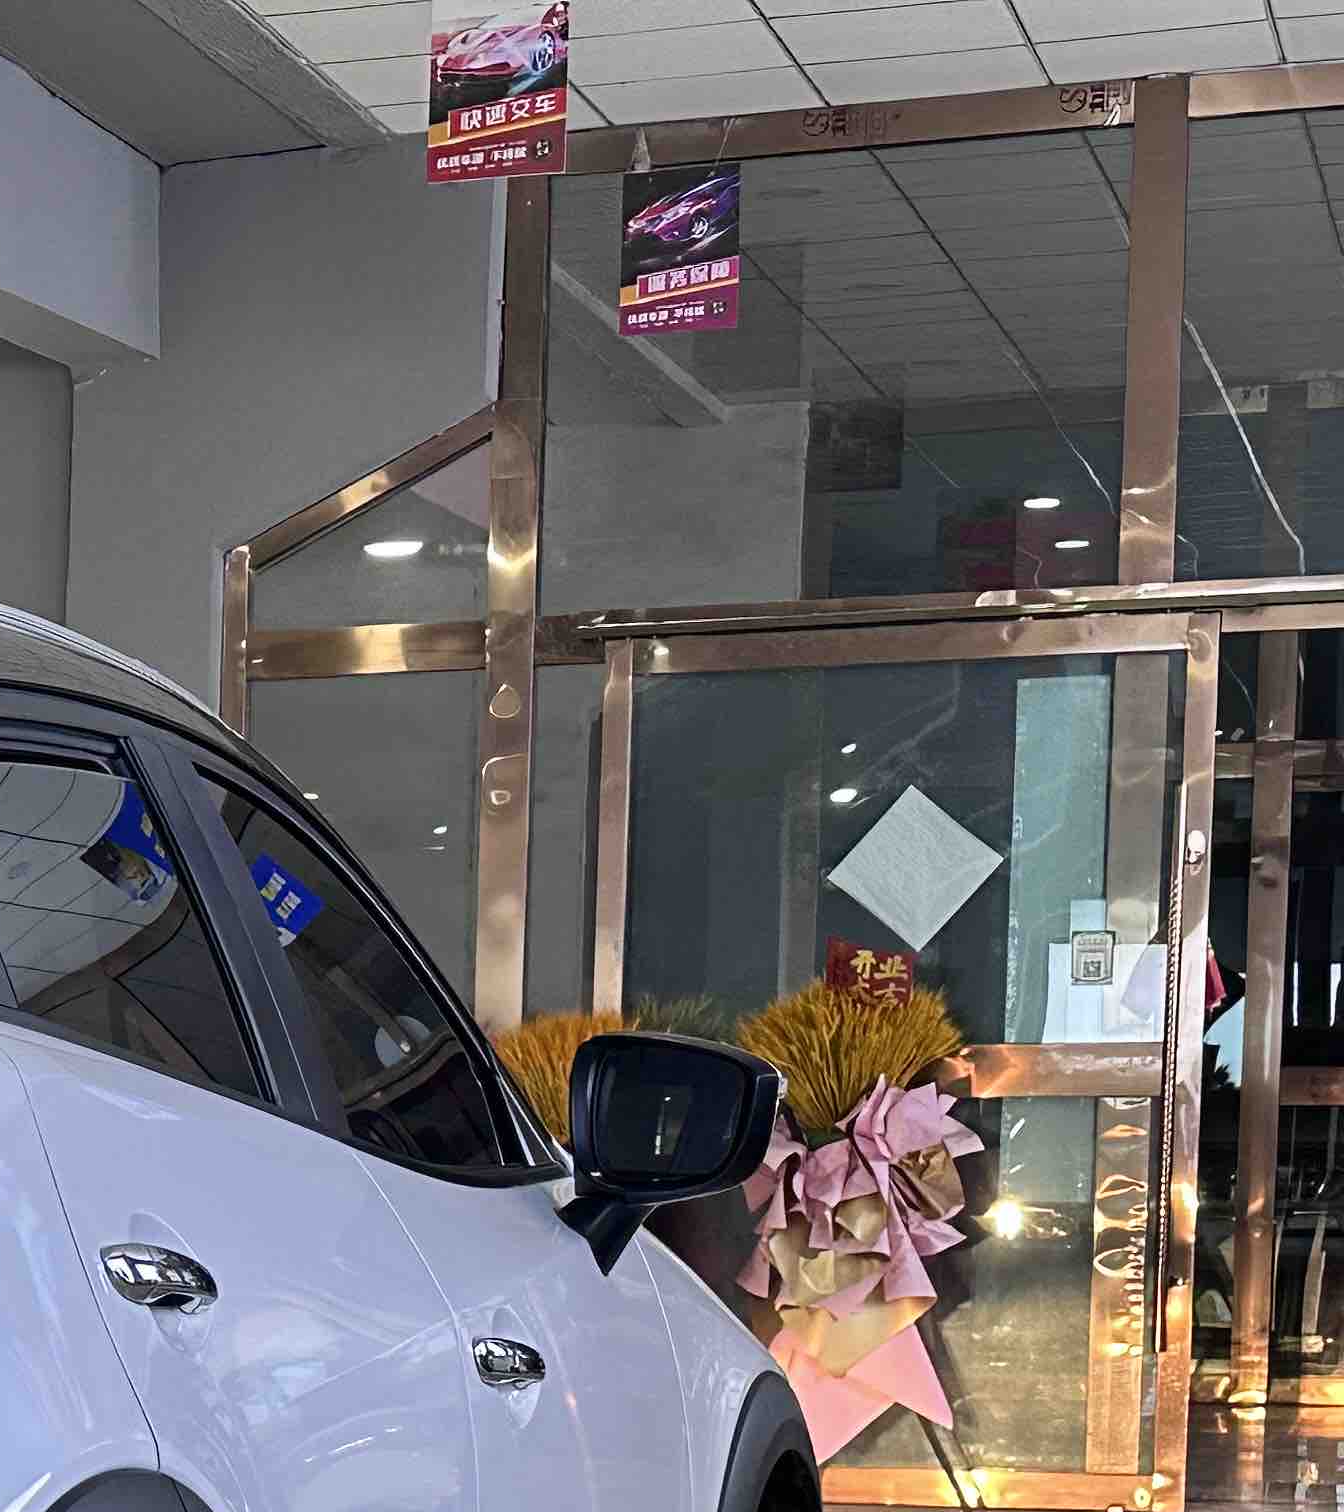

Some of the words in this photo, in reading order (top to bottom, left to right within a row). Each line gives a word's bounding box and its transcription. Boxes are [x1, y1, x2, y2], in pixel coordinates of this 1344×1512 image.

[460, 93, 556, 131] 快速交车
[849, 949, 909, 980] 开业
